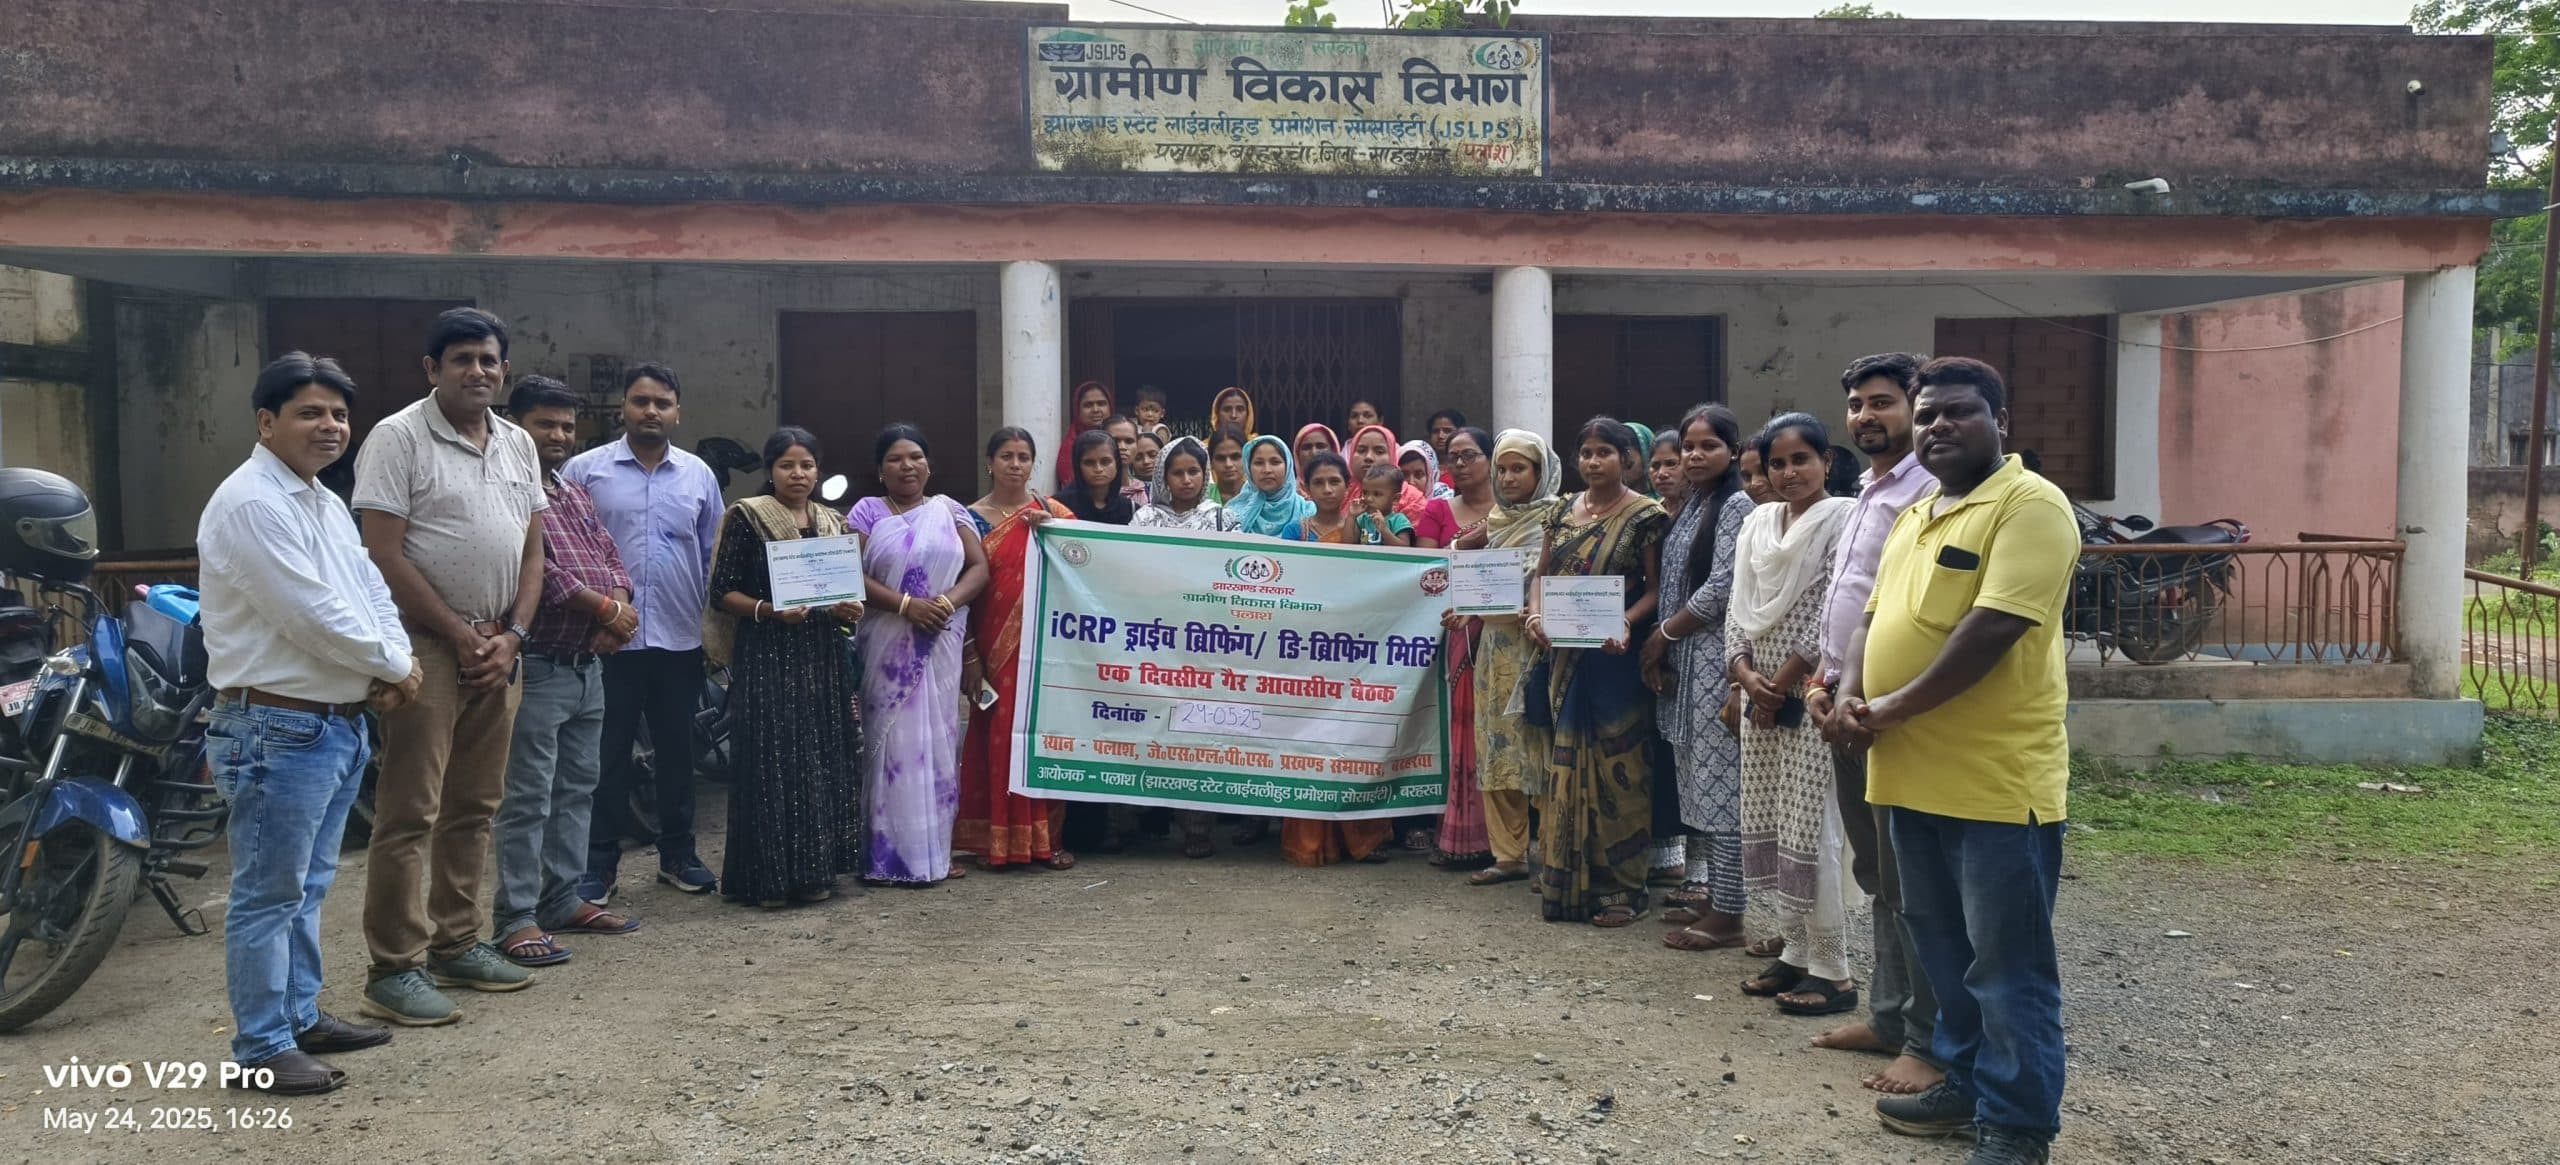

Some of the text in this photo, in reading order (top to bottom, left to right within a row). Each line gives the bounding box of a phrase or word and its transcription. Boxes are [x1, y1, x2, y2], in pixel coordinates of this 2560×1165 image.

[1087, 44, 1126, 61] JSLPS
[1050, 53, 1528, 112] ग्रामीण विकास विभाग
[1043, 114, 1120, 137] झारखण्ड
[1122, 112, 1159, 136] स्टेट
[1268, 111, 1337, 137] प्रमोशन
[1183, 592, 1322, 612] ग्रामीण विकास विभाग
[1212, 582, 1296, 597] झारखण्ड सरकार
[1230, 609, 1273, 621] पलाश
[1051, 611, 1116, 644] iCRP
[1124, 618, 1178, 652] ड्राईव
[1096, 662, 1398, 703] एक दिवसीय गैर आवासीय बैठक
[1091, 701, 1148, 723] दिनांक
[1042, 735, 1075, 752] स्थान
[1093, 739, 1141, 760] पलाश,
[1280, 754, 1325, 772] प्रखण्ड
[1037, 764, 1086, 783] आयोजक
[1100, 771, 1137, 787] पलाश
[1200, 777, 1224, 793] स्टेट
[1294, 785, 1338, 802] प्रमोशन
[1400, 783, 1443, 798] बरहरवा
